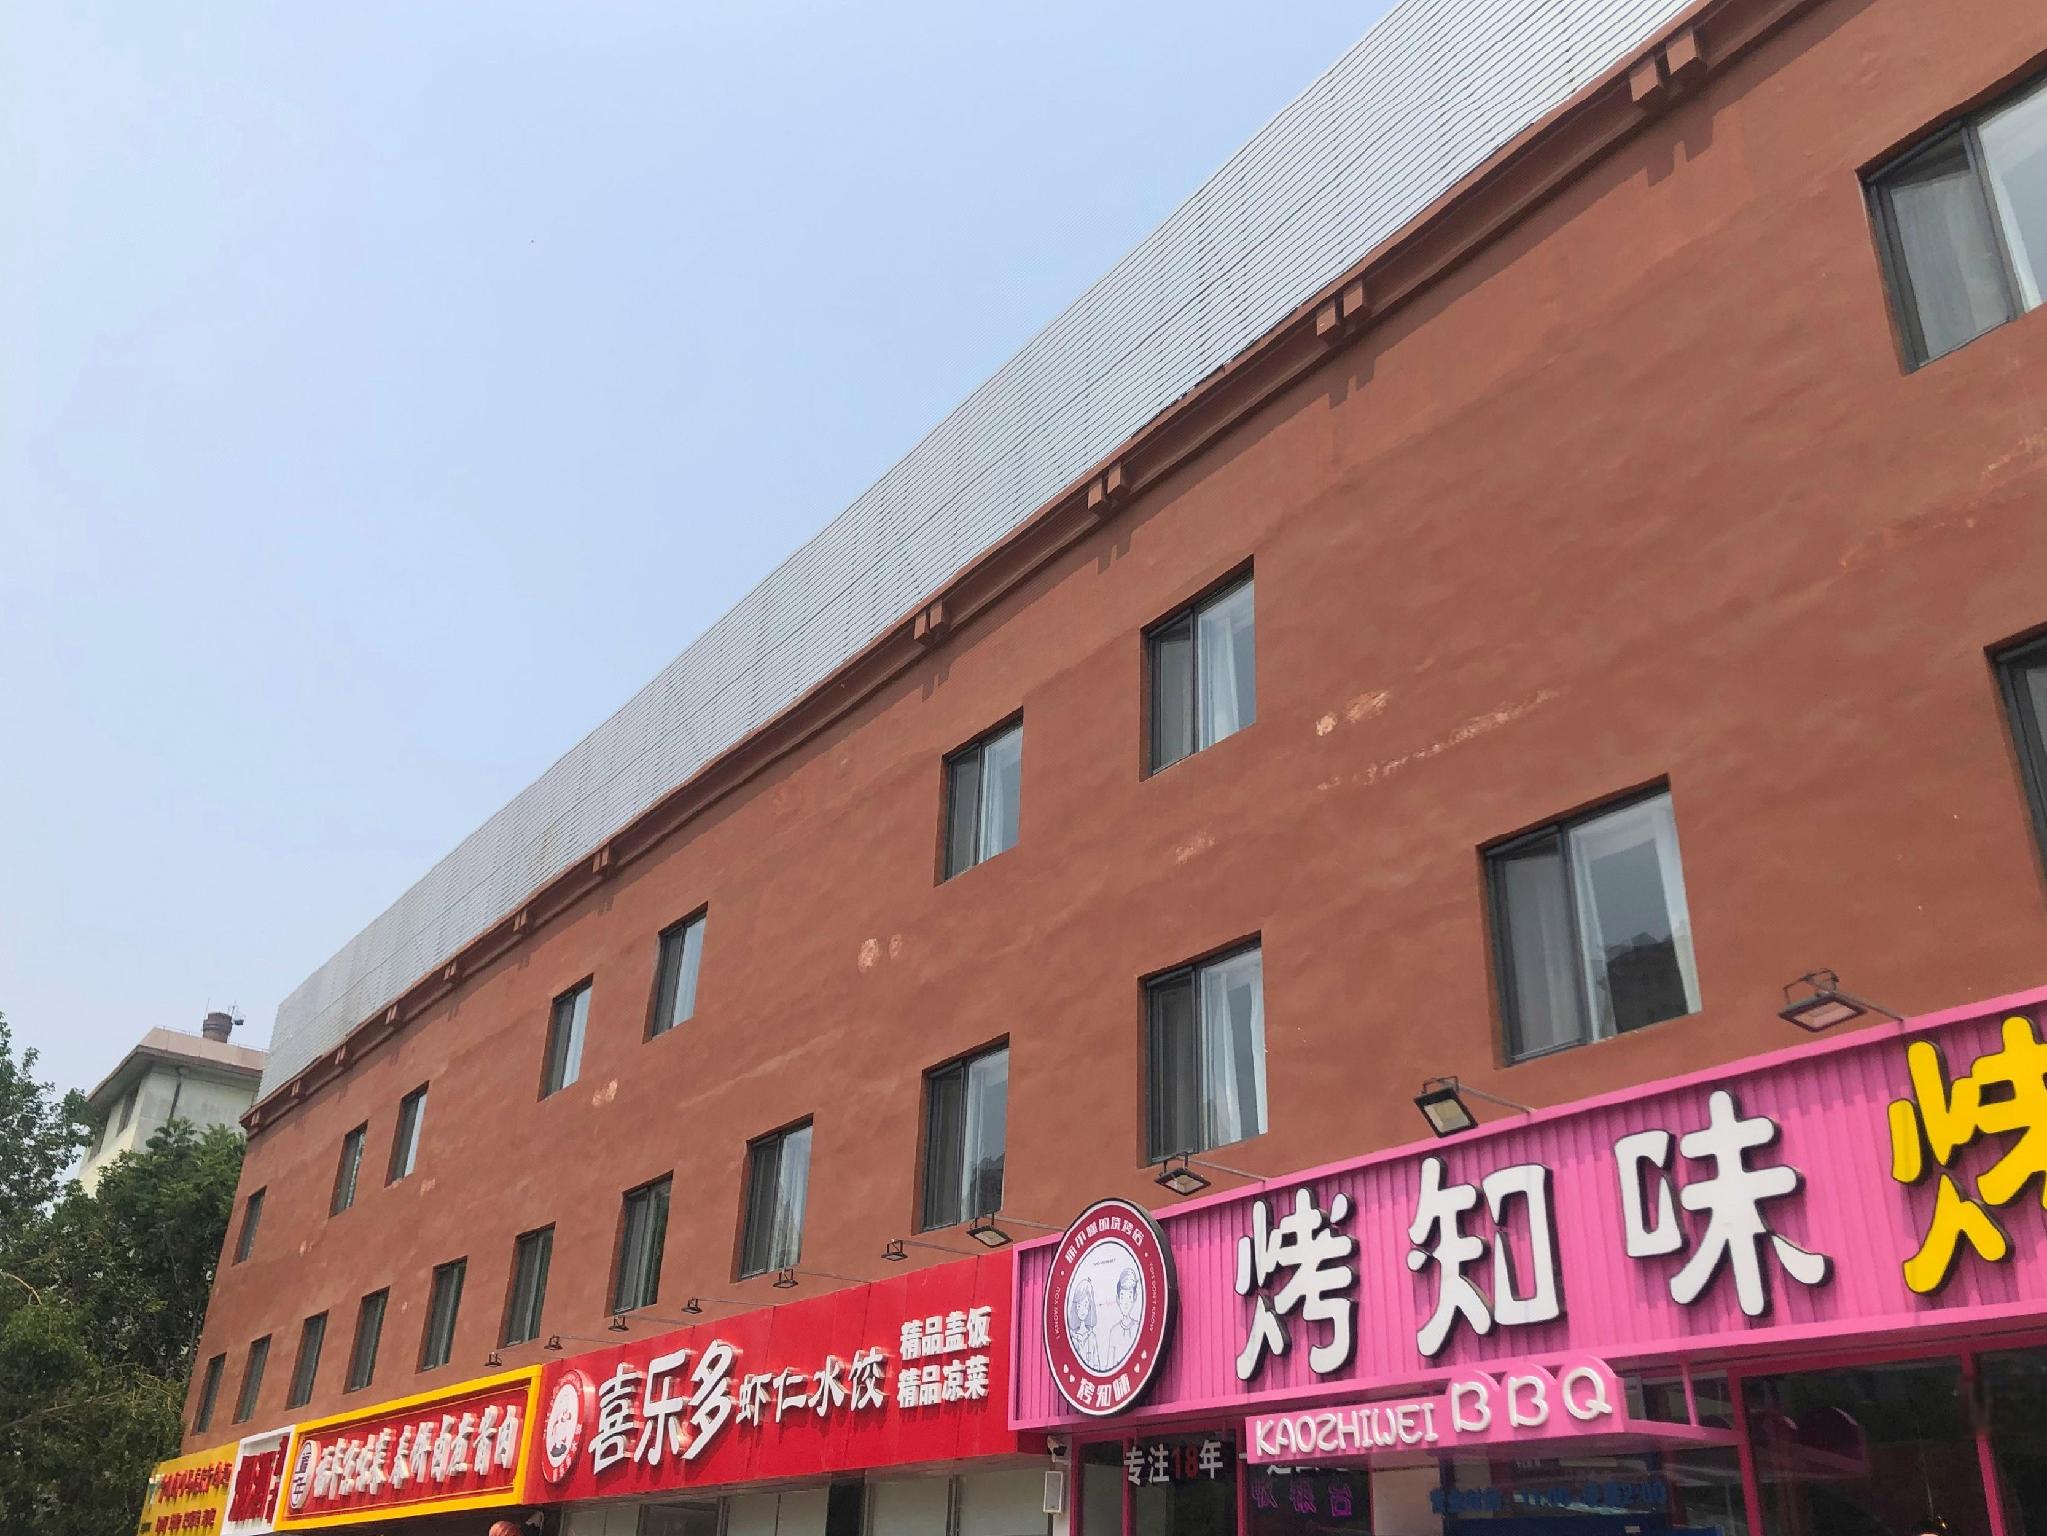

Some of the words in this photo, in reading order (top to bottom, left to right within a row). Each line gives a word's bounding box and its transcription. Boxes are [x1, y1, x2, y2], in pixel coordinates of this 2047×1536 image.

[900, 1306, 991, 1360] 精品盖饭
[897, 1355, 989, 1408] 精品凉菜
[1453, 1366, 1613, 1433] BBQ
[1123, 1439, 1224, 1486] 专注18年
